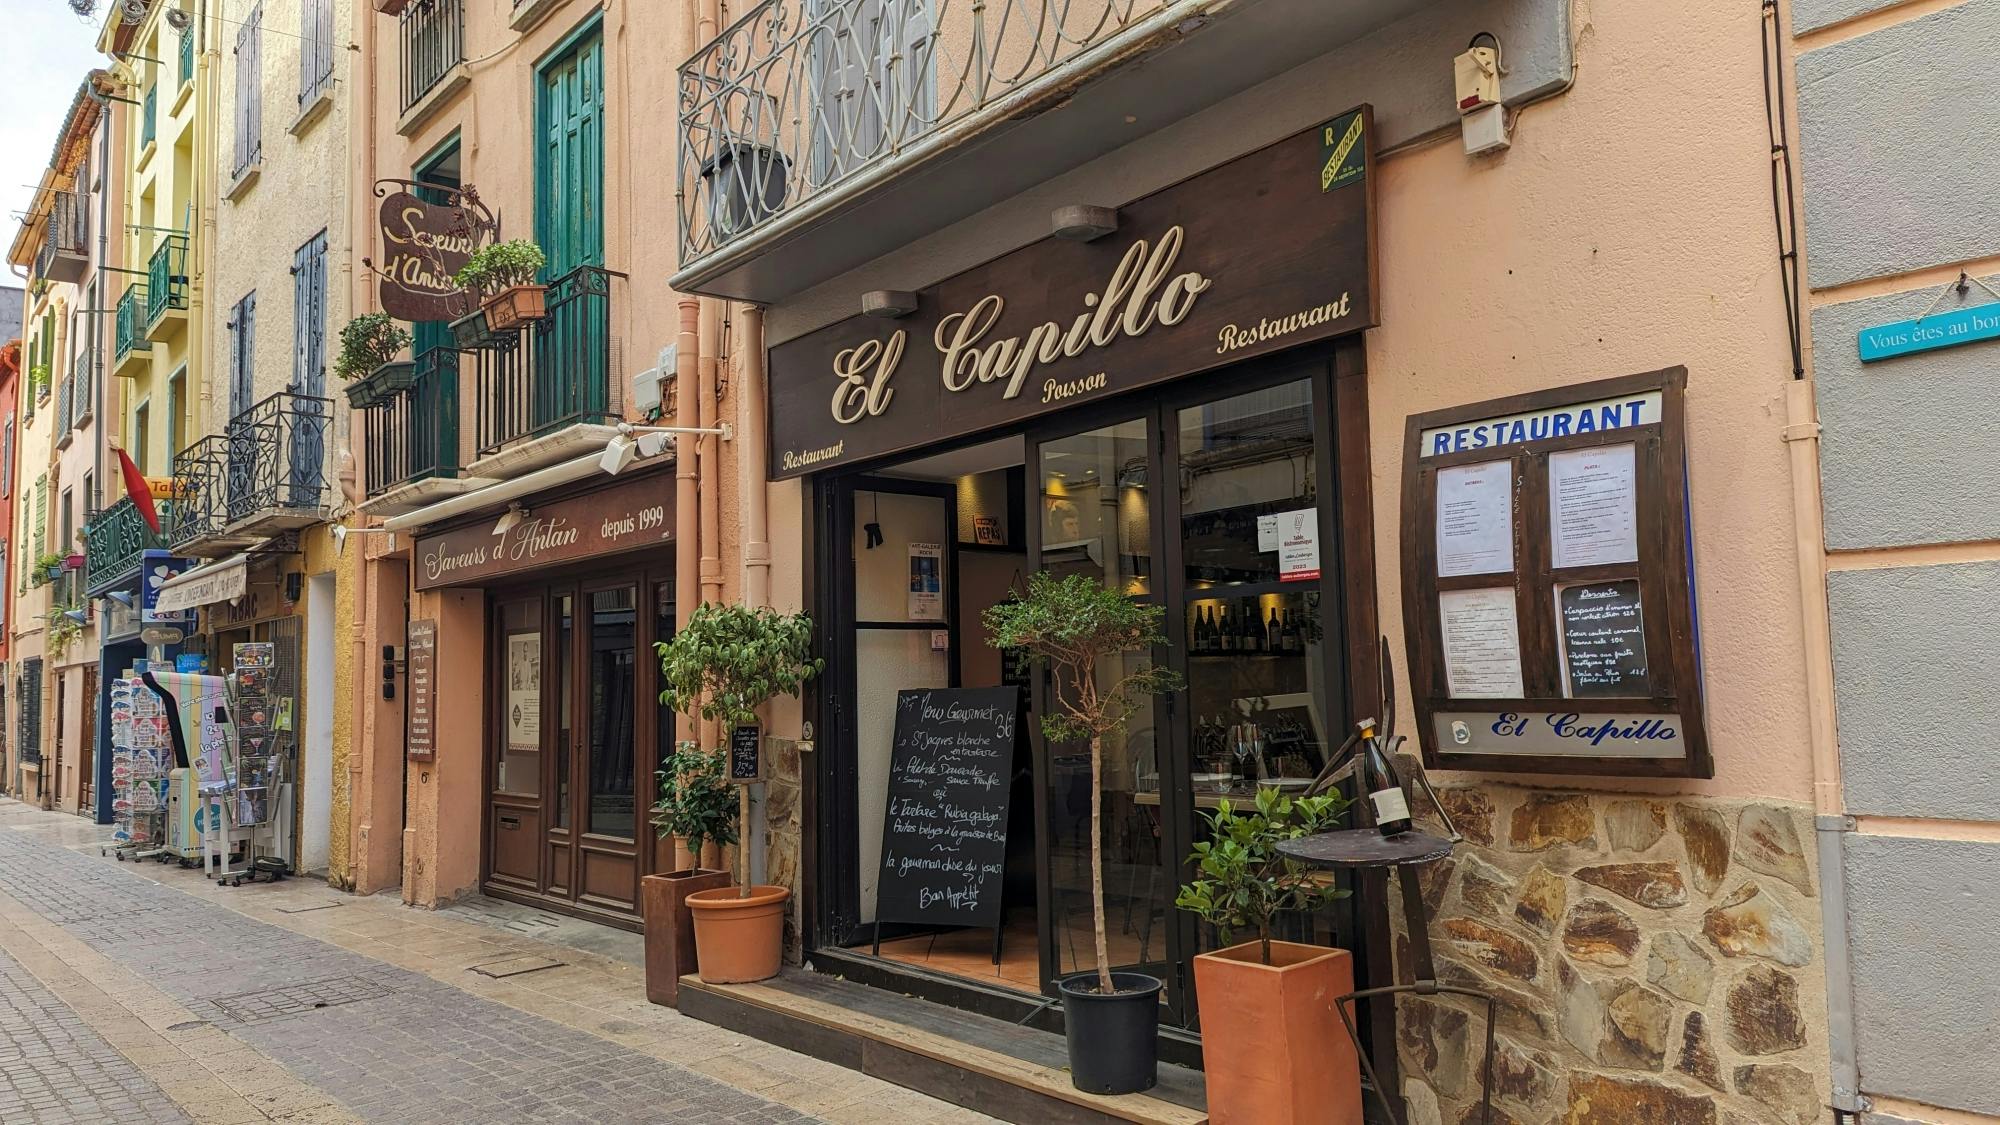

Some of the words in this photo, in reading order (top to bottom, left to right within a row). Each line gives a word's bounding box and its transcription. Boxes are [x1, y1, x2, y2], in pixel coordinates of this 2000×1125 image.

[1323, 114, 1362, 187] RESTAURANT
[1325, 127, 1334, 146] R
[831, 329, 906, 425] El
[934, 224, 1212, 400] Capillo
[1216, 291, 1352, 354] Restaurant
[1869, 333, 1908, 350] Vous
[1912, 327, 1944, 342] êtes
[1948, 322, 1968, 336] au
[1041, 372, 1108, 404] Poisson
[1434, 399, 1646, 457] RESTAURANT
[782, 439, 845, 472] Restaurant
[601, 513, 636, 542] depuis
[638, 506, 665, 531] 1999
[424, 542, 489, 581] Saveurs
[946, 701, 999, 723] Gourmet
[1491, 712, 1529, 737] El
[1545, 712, 1677, 746] Capillo
